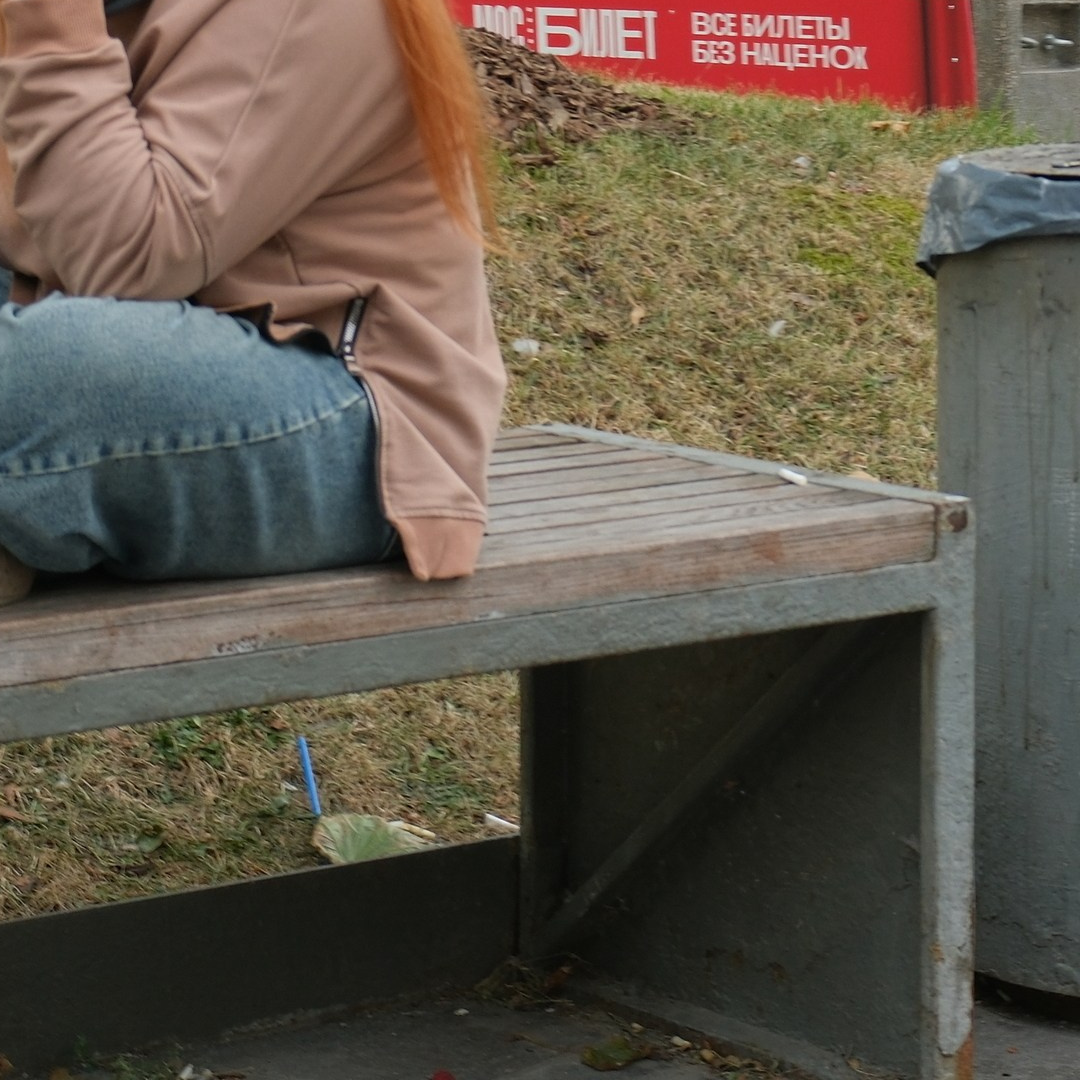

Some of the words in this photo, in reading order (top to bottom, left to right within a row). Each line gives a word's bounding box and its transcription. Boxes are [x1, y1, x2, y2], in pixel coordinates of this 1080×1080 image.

[691, 11, 738, 37] ВСЕ
[741, 14, 850, 41] БИЛЕТЫ
[691, 40, 736, 65] БЕЗ
[740, 42, 869, 71] НАЦЕНОК
